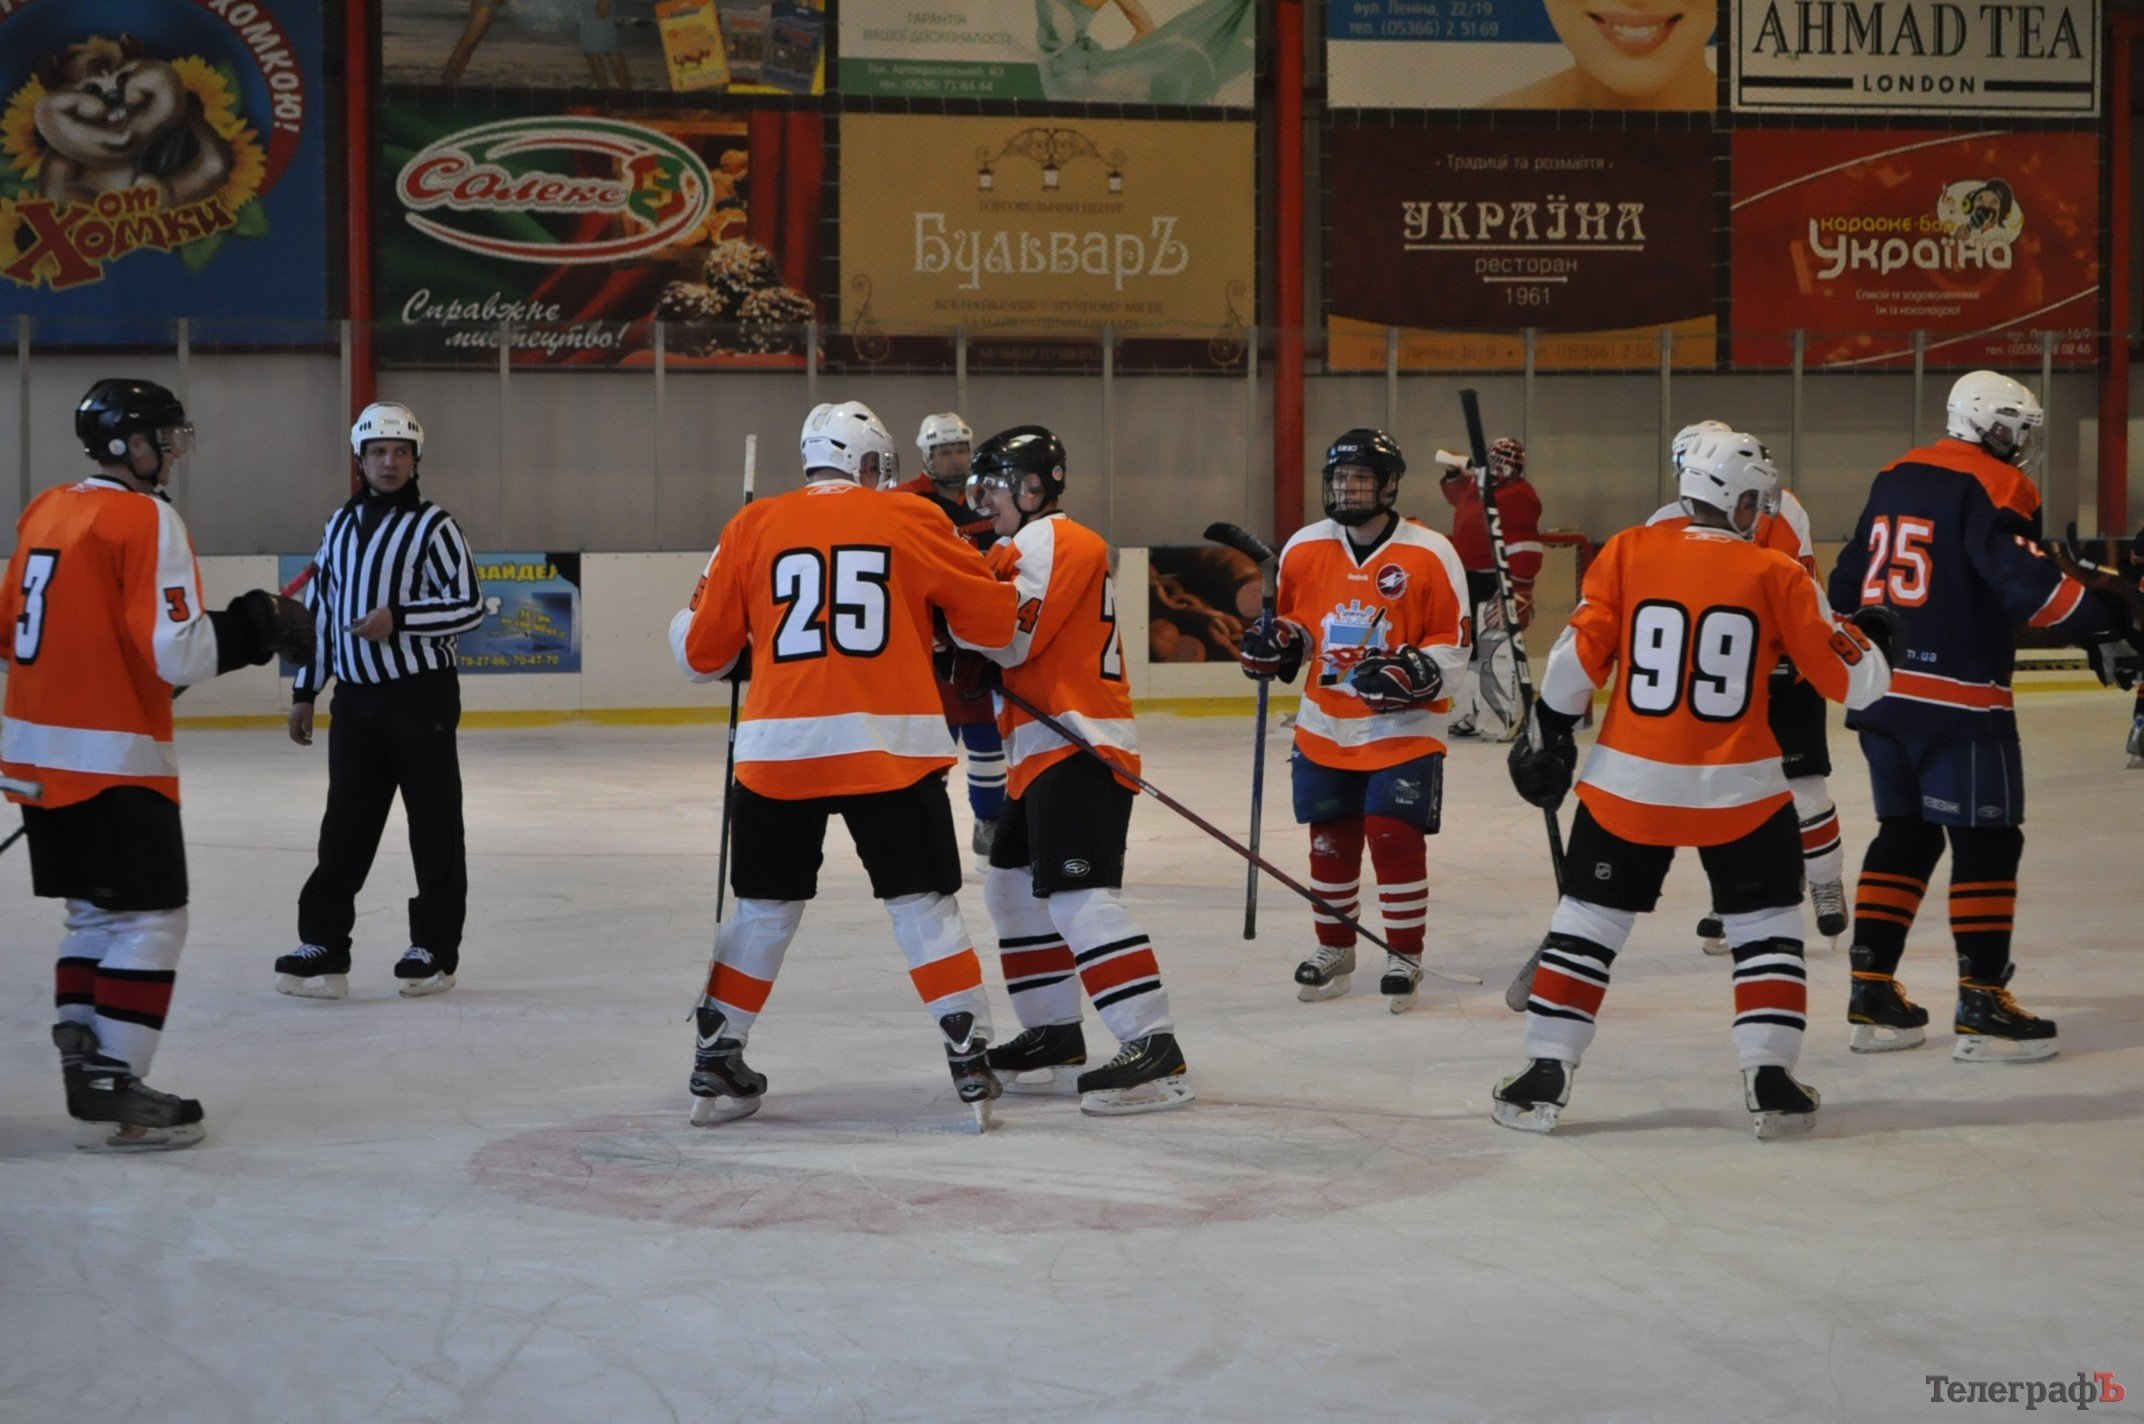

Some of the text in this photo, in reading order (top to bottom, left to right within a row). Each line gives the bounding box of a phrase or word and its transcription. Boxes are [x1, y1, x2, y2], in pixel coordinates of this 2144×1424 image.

[1446, 21, 1456, 35] 2
[1752, 0, 2084, 60] AHMAD TEA
[1862, 74, 1976, 94] LONDON
[1402, 193, 1646, 240] УКРАЇНА
[1474, 256, 1578, 275] ресторан
[1808, 217, 2013, 280] Україна
[401, 289, 562, 327] Справжне
[1504, 287, 1551, 306] 1961
[1861, 514, 1935, 608] 25
[15, 548, 60, 666] 3
[163, 586, 190, 623] 3
[773, 544, 893, 664] 25
[1627, 597, 1760, 723] 99
